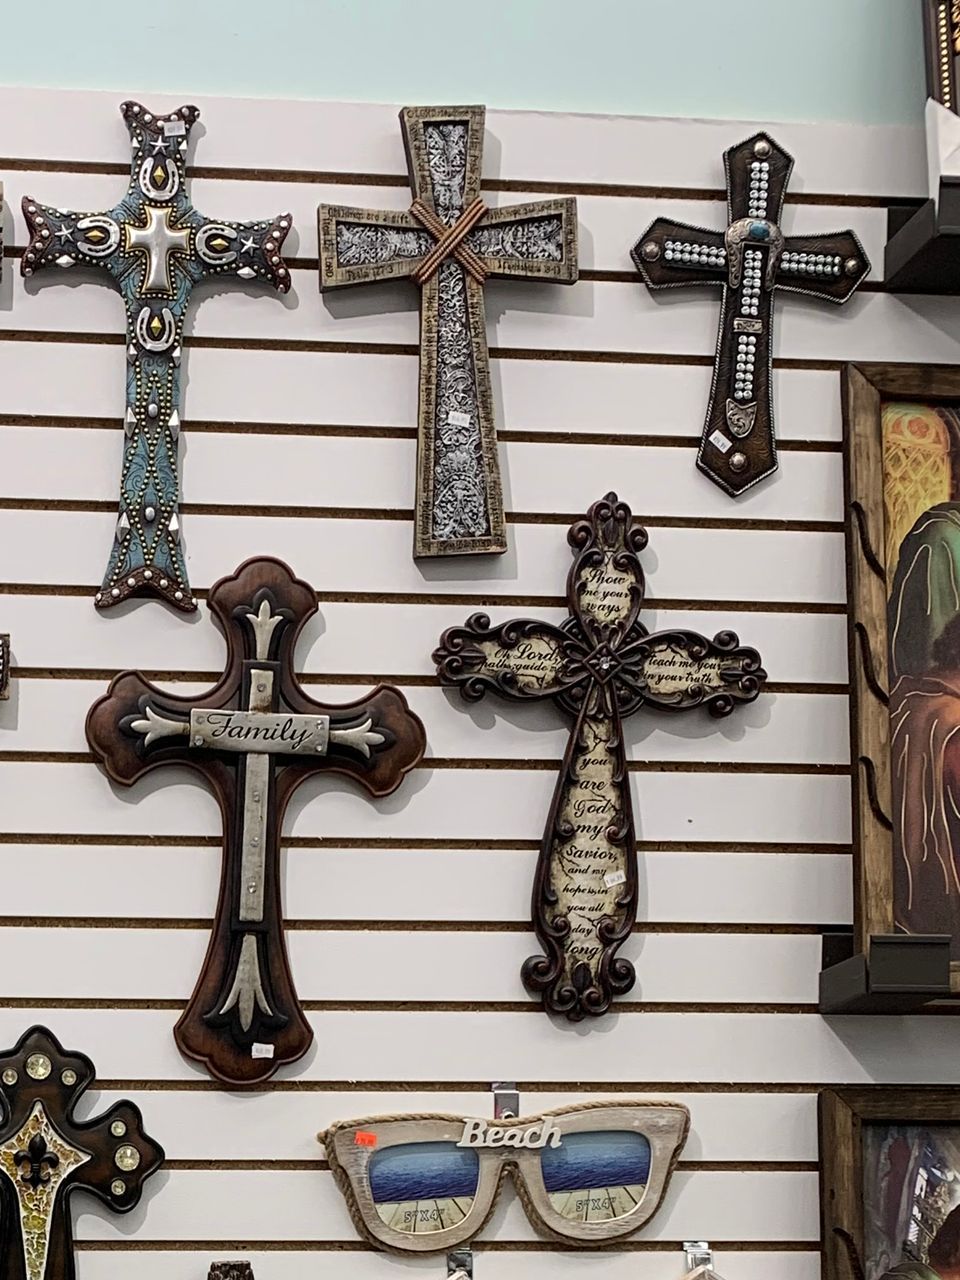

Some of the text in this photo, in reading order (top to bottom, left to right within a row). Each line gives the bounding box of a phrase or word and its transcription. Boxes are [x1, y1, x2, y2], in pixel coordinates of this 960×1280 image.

[585, 569, 628, 584] Show
[582, 587, 631, 600] me your
[585, 602, 624, 617] ways
[494, 648, 511, 660] Oh
[648, 653, 721, 675] teach me your
[656, 672, 685, 685] your
[685, 672, 713, 684] truth
[207, 713, 313, 750] Family
[579, 757, 610, 771] you
[579, 780, 608, 791] are
[573, 800, 611, 818] God
[574, 824, 606, 841] my
[566, 845, 617, 864] Savior,
[567, 866, 590, 875] and
[591, 868, 607, 881] my
[562, 884, 587, 899] hope
[567, 902, 605, 914] you all
[571, 925, 594, 938] day
[565, 940, 602, 961] long
[456, 1116, 564, 1149] Beach
